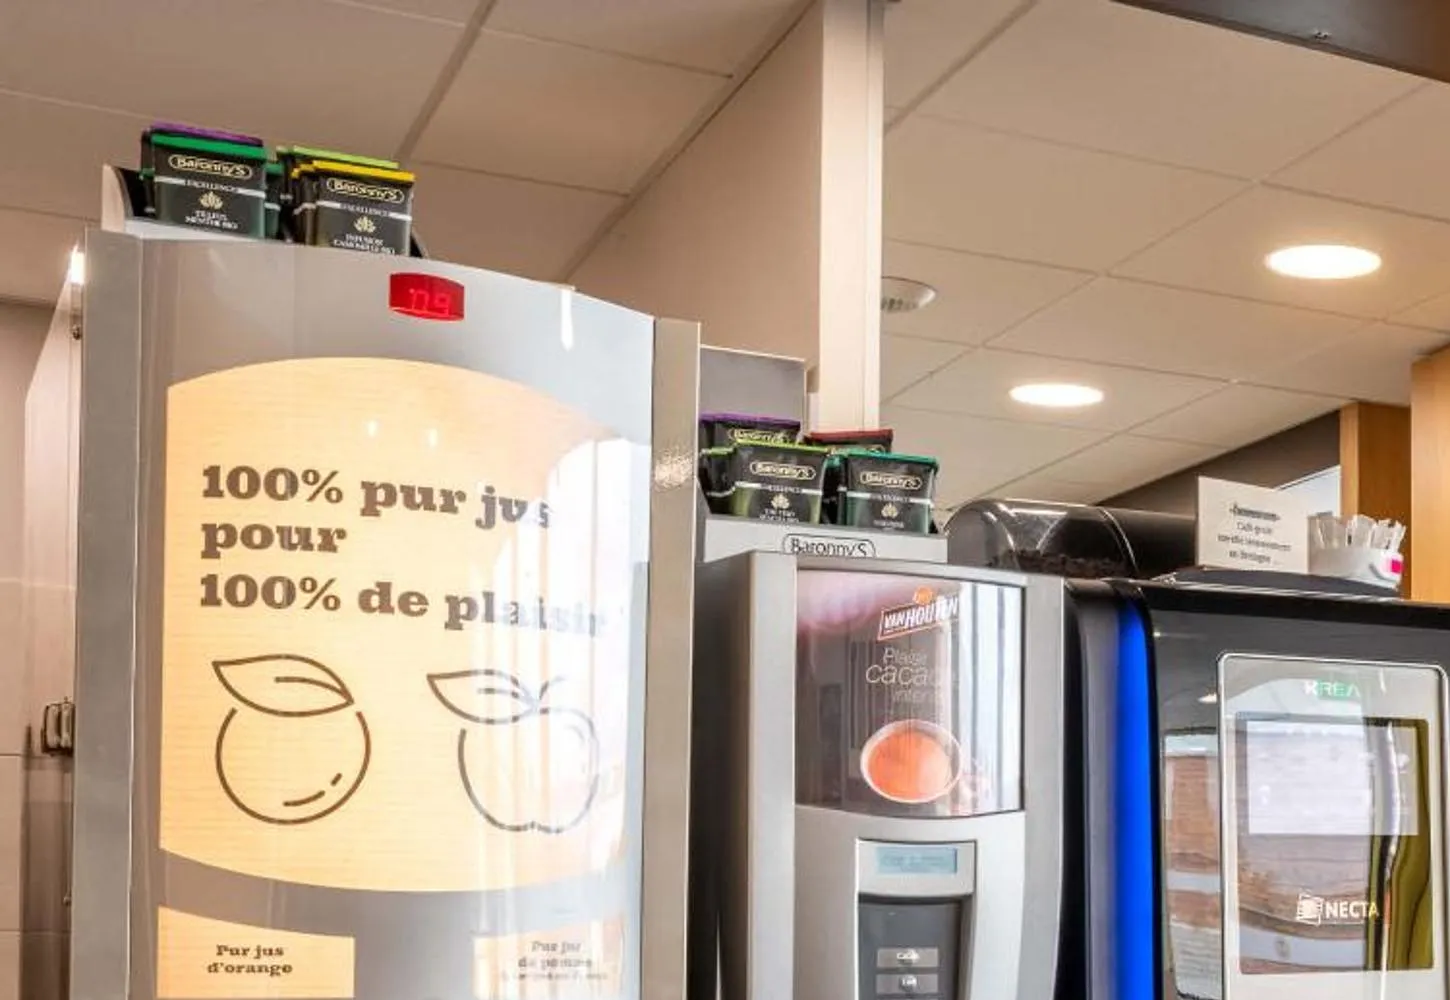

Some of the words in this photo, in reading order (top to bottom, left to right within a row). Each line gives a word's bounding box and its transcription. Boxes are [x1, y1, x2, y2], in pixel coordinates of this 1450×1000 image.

[201, 464, 344, 505] 100%
[359, 478, 466, 518] pur
[475, 485, 550, 530] jus
[200, 521, 347, 559] pour
[199, 573, 342, 612] 100%
[358, 581, 430, 618] de
[1325, 901, 1380, 918] NECTA
[216, 944, 250, 957] Pur
[253, 944, 285, 960] jus
[207, 961, 293, 977] d'orange
